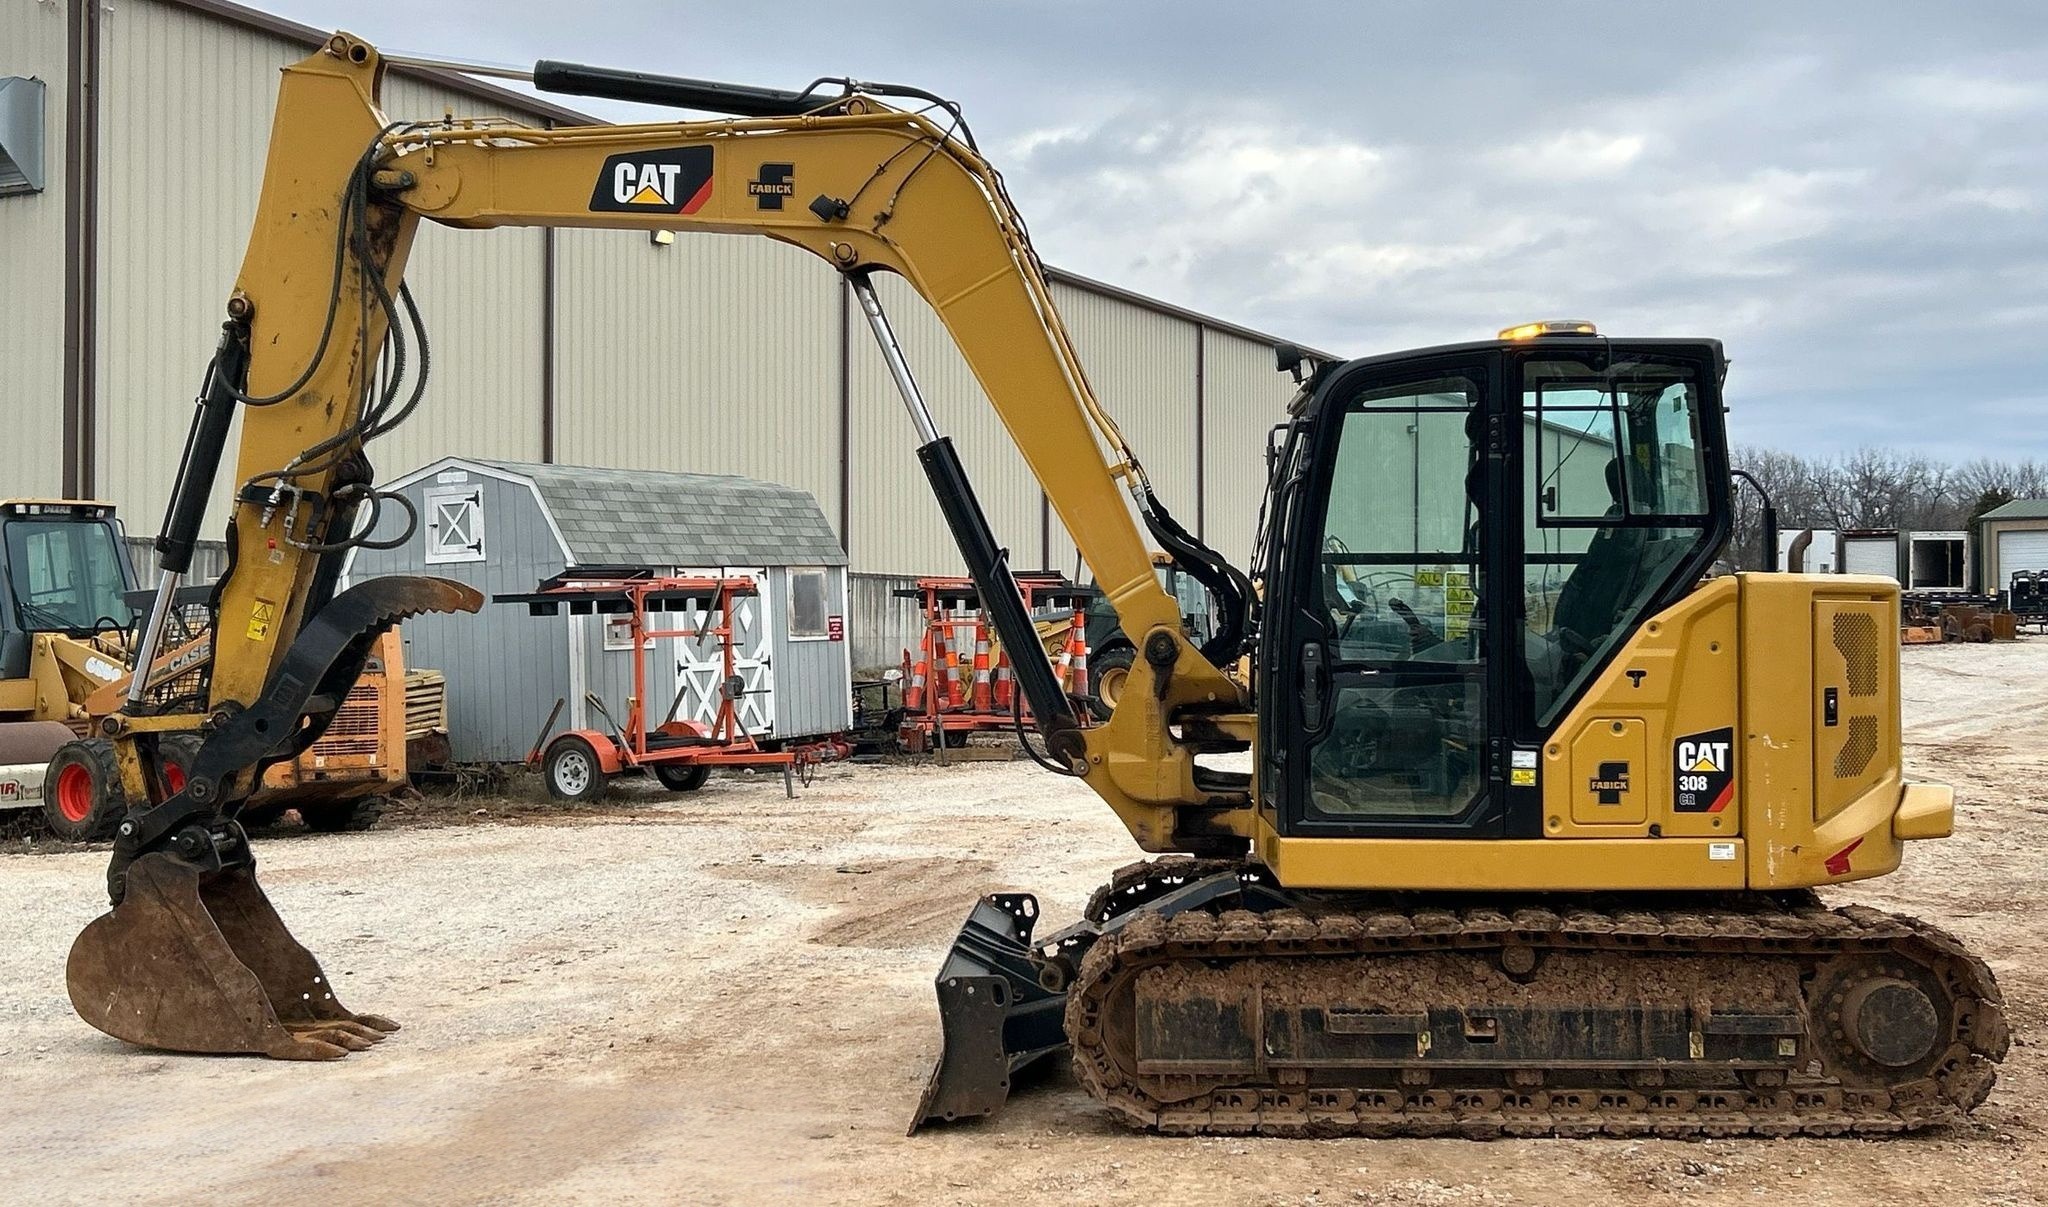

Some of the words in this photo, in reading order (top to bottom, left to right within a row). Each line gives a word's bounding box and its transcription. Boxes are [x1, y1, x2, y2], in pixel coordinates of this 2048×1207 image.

[614, 162, 681, 205] CAT
[750, 184, 792, 194] FABICK
[170, 642, 211, 672] CASE
[1679, 742, 1729, 772] CAT
[1592, 781, 1627, 789] FABICK
[1679, 776, 1708, 791] 308
[1679, 793, 1696, 806] CR
